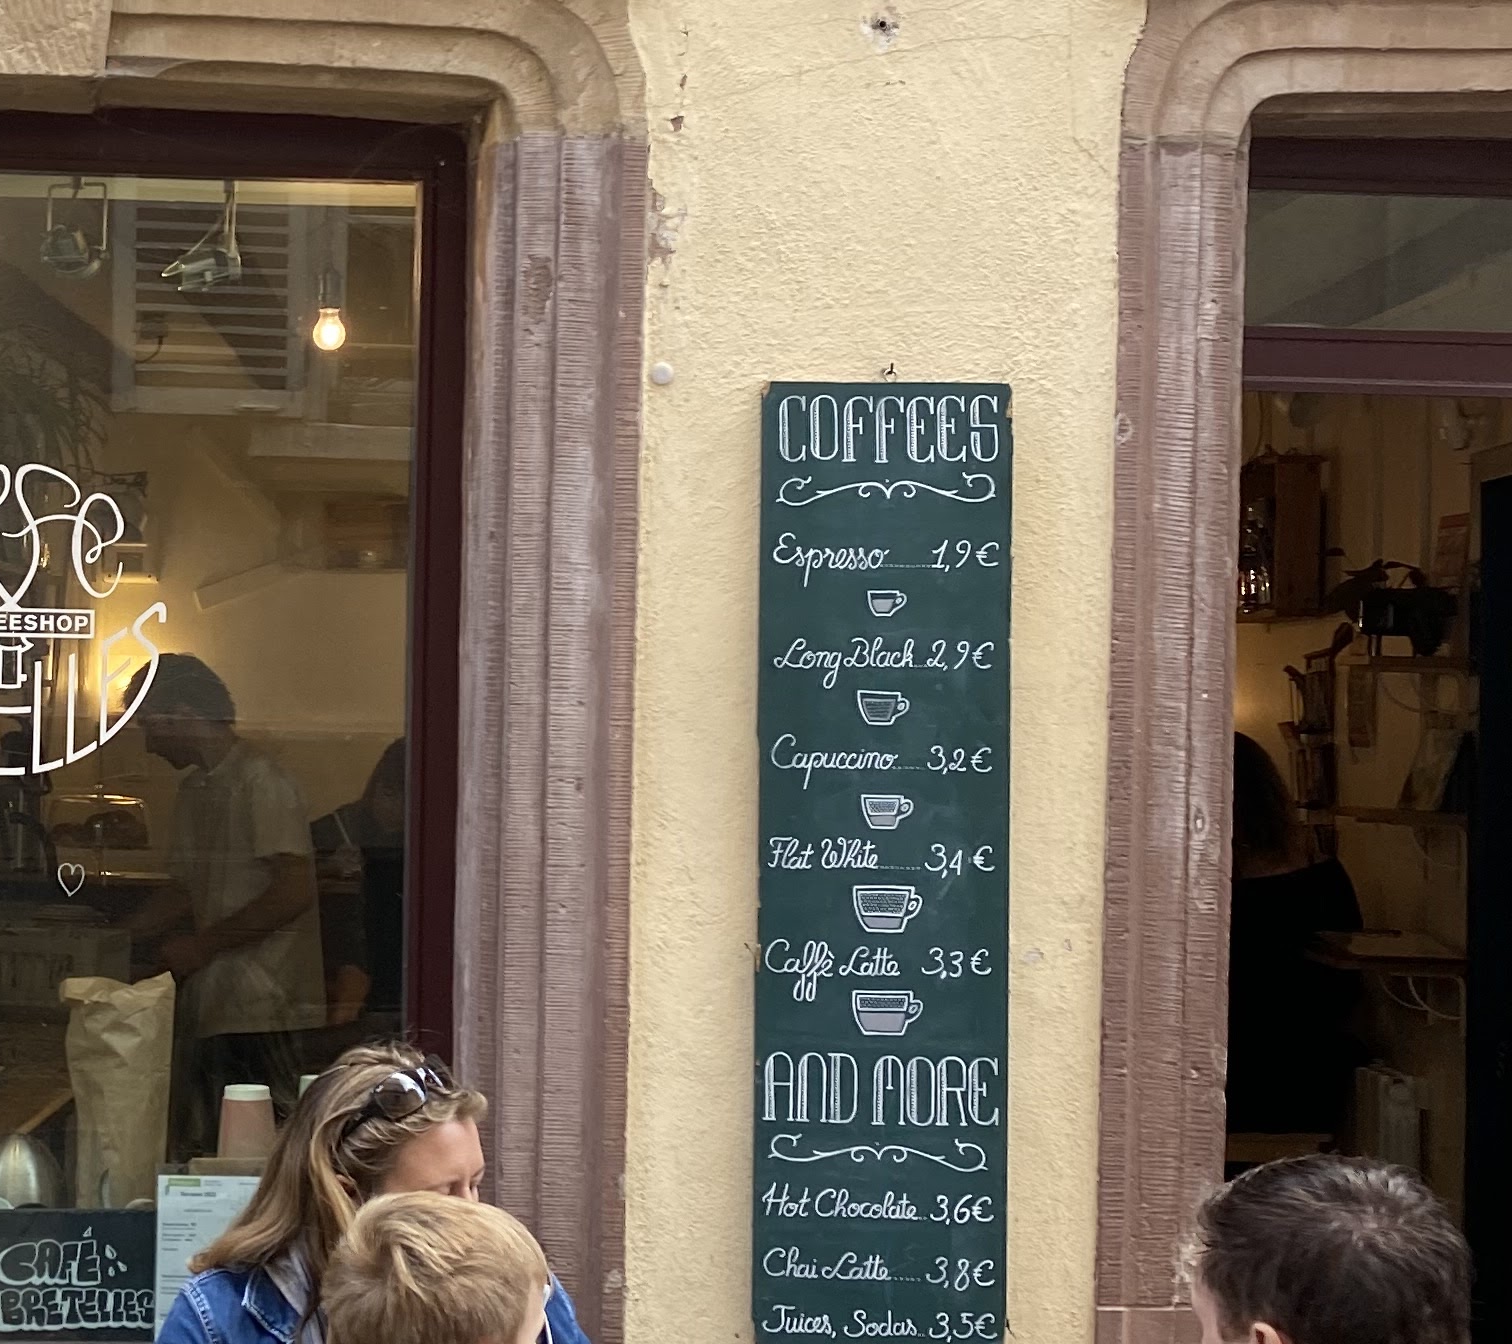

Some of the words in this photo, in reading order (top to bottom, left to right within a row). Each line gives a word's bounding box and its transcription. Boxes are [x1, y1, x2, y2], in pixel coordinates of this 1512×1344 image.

[777, 394, 999, 463] COFFEES
[772, 532, 891, 587] Espresso
[773, 636, 843, 689] Long
[843, 636, 915, 669] Black
[771, 733, 899, 790] Capuccino
[768, 836, 814, 871] Flat
[821, 837, 880, 870] White
[763, 938, 835, 1001] Caffè
[839, 945, 901, 977] Latte
[761, 1051, 859, 1124] AND
[872, 1055, 1000, 1127] MORE
[761, 1182, 811, 1219] Hot
[814, 1187, 919, 1221] Chocolate
[763, 1246, 819, 1279] Chai
[820, 1253, 890, 1282] Latte
[762, 1304, 837, 1340] Juices,
[843, 1309, 918, 1338] Sodas
